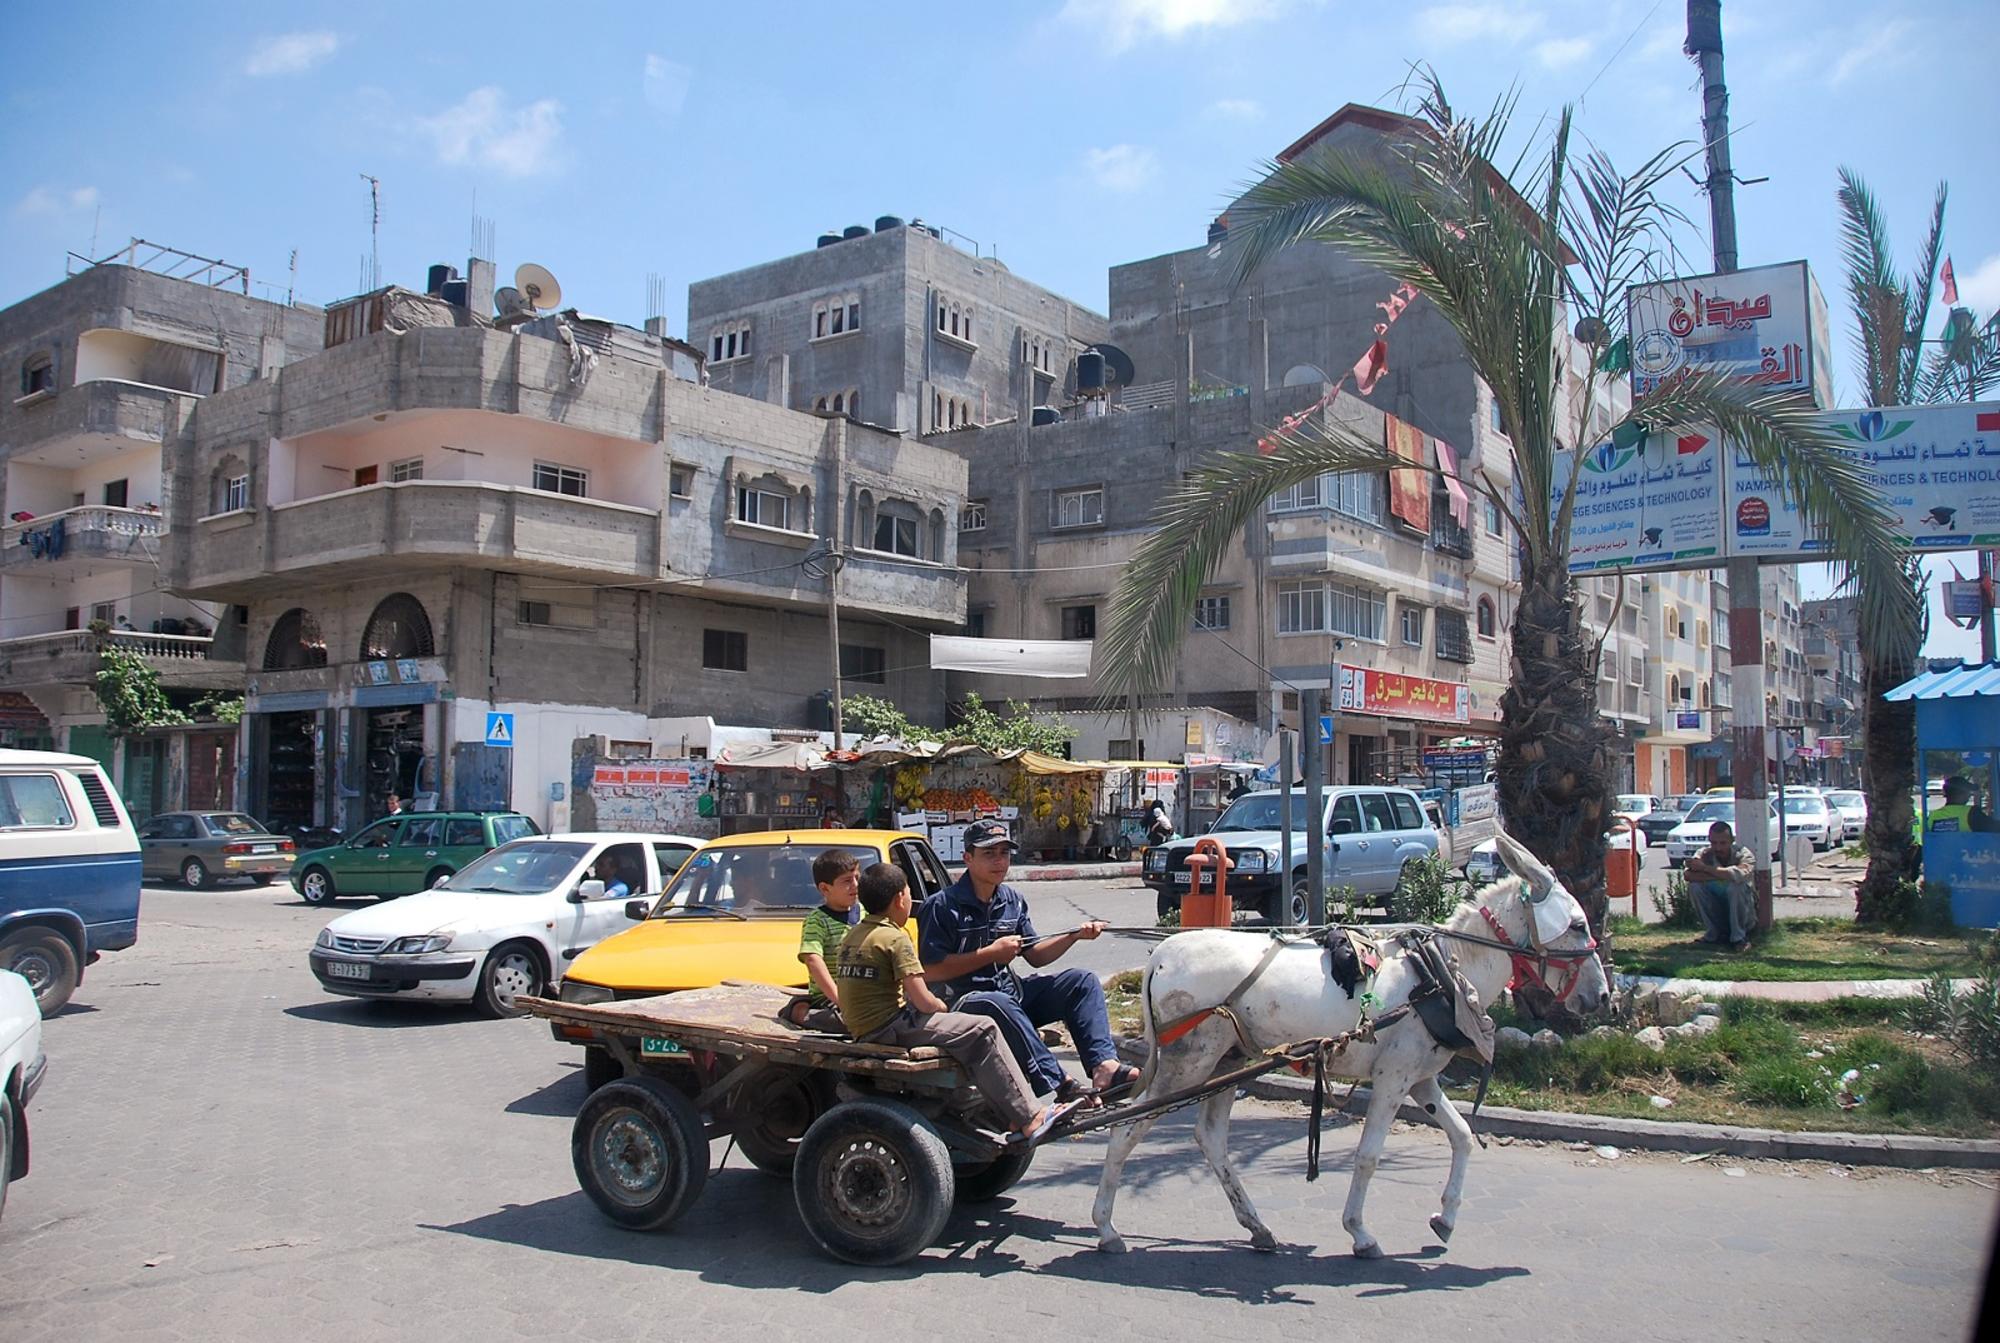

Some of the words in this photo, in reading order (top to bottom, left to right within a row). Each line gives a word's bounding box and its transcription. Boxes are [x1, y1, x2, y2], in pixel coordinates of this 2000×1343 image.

[1668, 288, 1771, 337] ميدان
[1922, 441, 1971, 461] نماء
[1639, 464, 1674, 485] نماء
[1677, 459, 1712, 480] كلية
[1919, 472, 1928, 481] &
[1600, 471, 1637, 494] للعلوم
[1592, 498, 1635, 515] SCIENCES
[1637, 497, 1645, 507] &
[1646, 487, 1713, 506] TECHNOLOGY
[1375, 673, 1407, 702] الشرق
[1408, 680, 1427, 705] فجر
[1427, 682, 1450, 708] شركة
